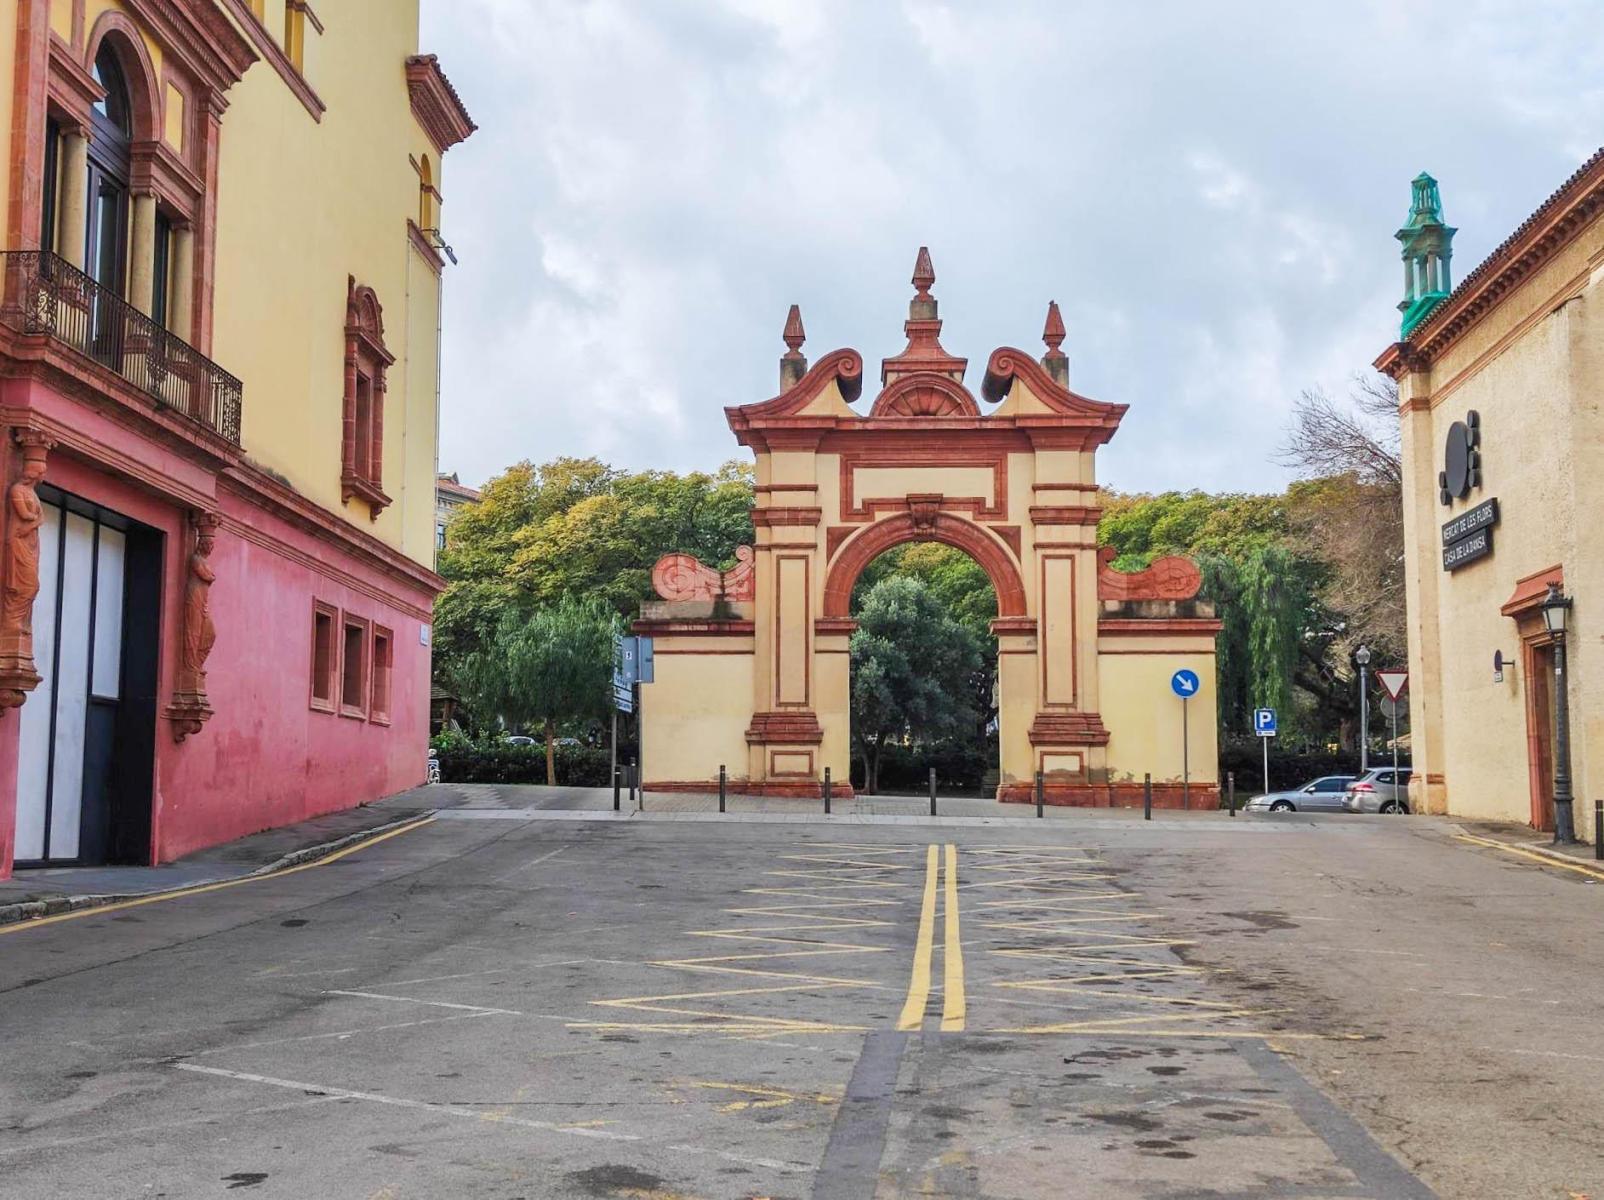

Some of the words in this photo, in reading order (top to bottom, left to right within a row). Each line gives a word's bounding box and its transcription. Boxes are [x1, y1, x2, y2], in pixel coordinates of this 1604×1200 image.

[1460, 518, 1467, 533] DE
[1467, 513, 1476, 528] LES
[1477, 505, 1492, 523] FLORS
[1444, 550, 1456, 565] CASA
[1456, 546, 1463, 559] DE
[1463, 543, 1469, 557] LA
[1259, 711, 1272, 728] P
